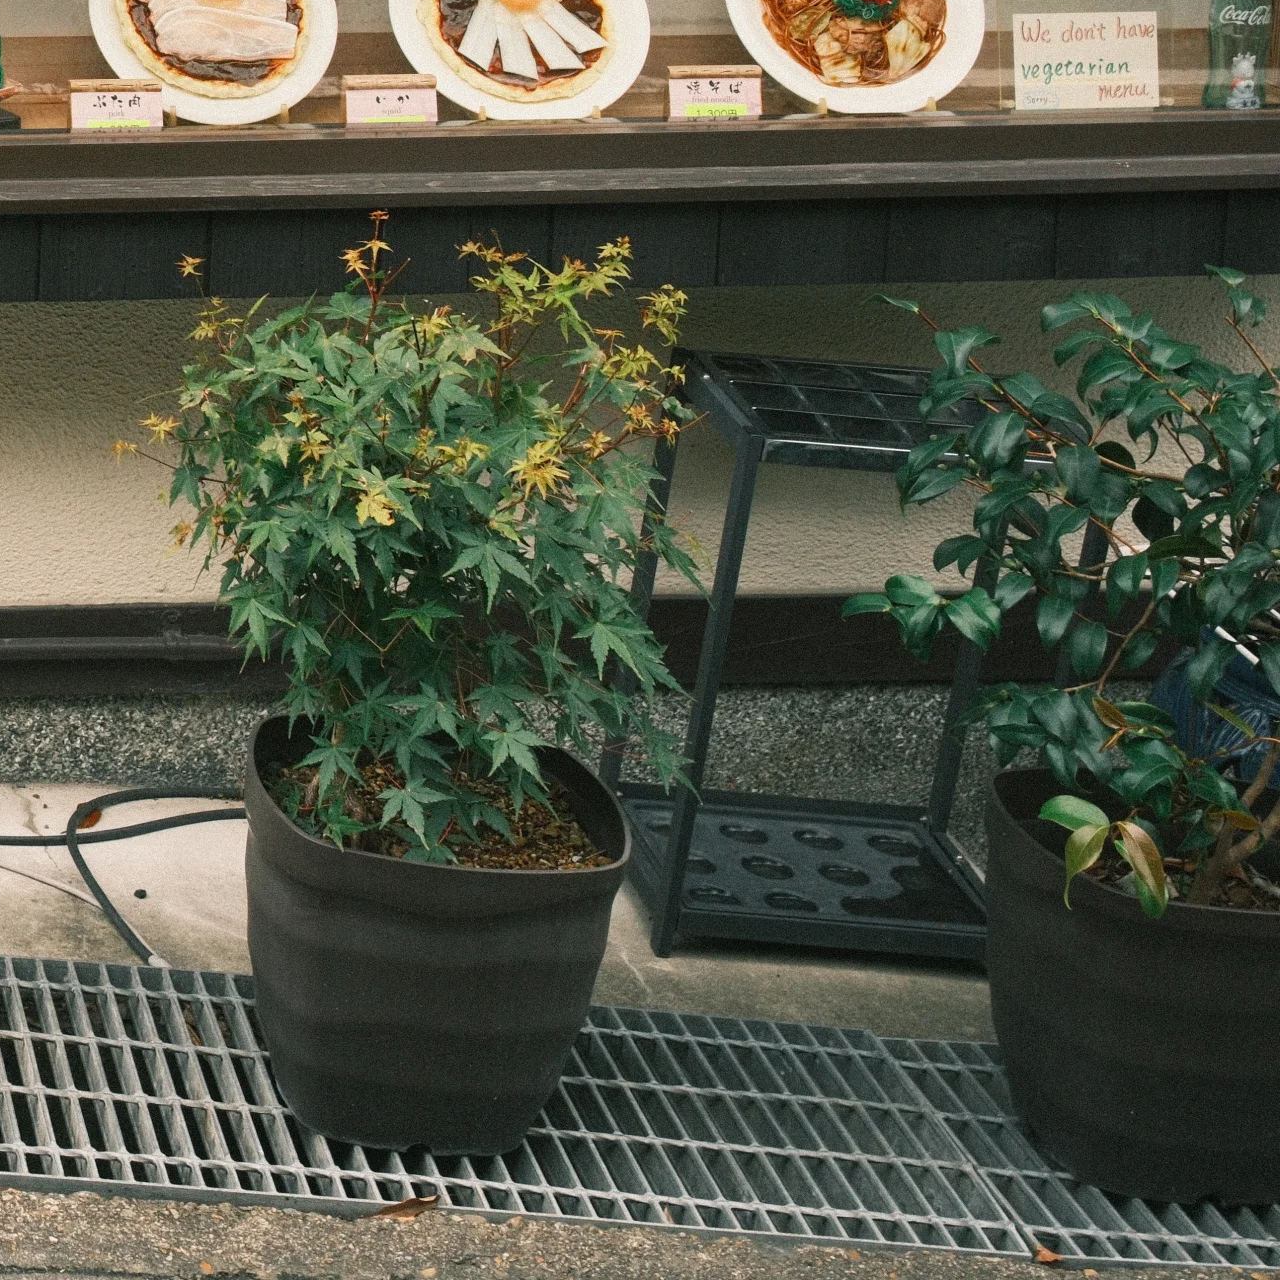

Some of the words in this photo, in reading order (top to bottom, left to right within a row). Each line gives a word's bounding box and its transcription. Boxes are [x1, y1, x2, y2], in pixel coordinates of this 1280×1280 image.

[1020, 18, 1051, 43] We
[1061, 20, 1107, 43] don't
[1116, 16, 1155, 40] have
[1021, 58, 1130, 85] vegetarian
[686, 80, 743, 95] 焼そば
[92, 94, 141, 108] ぶた肉
[375, 94, 410, 104] いか
